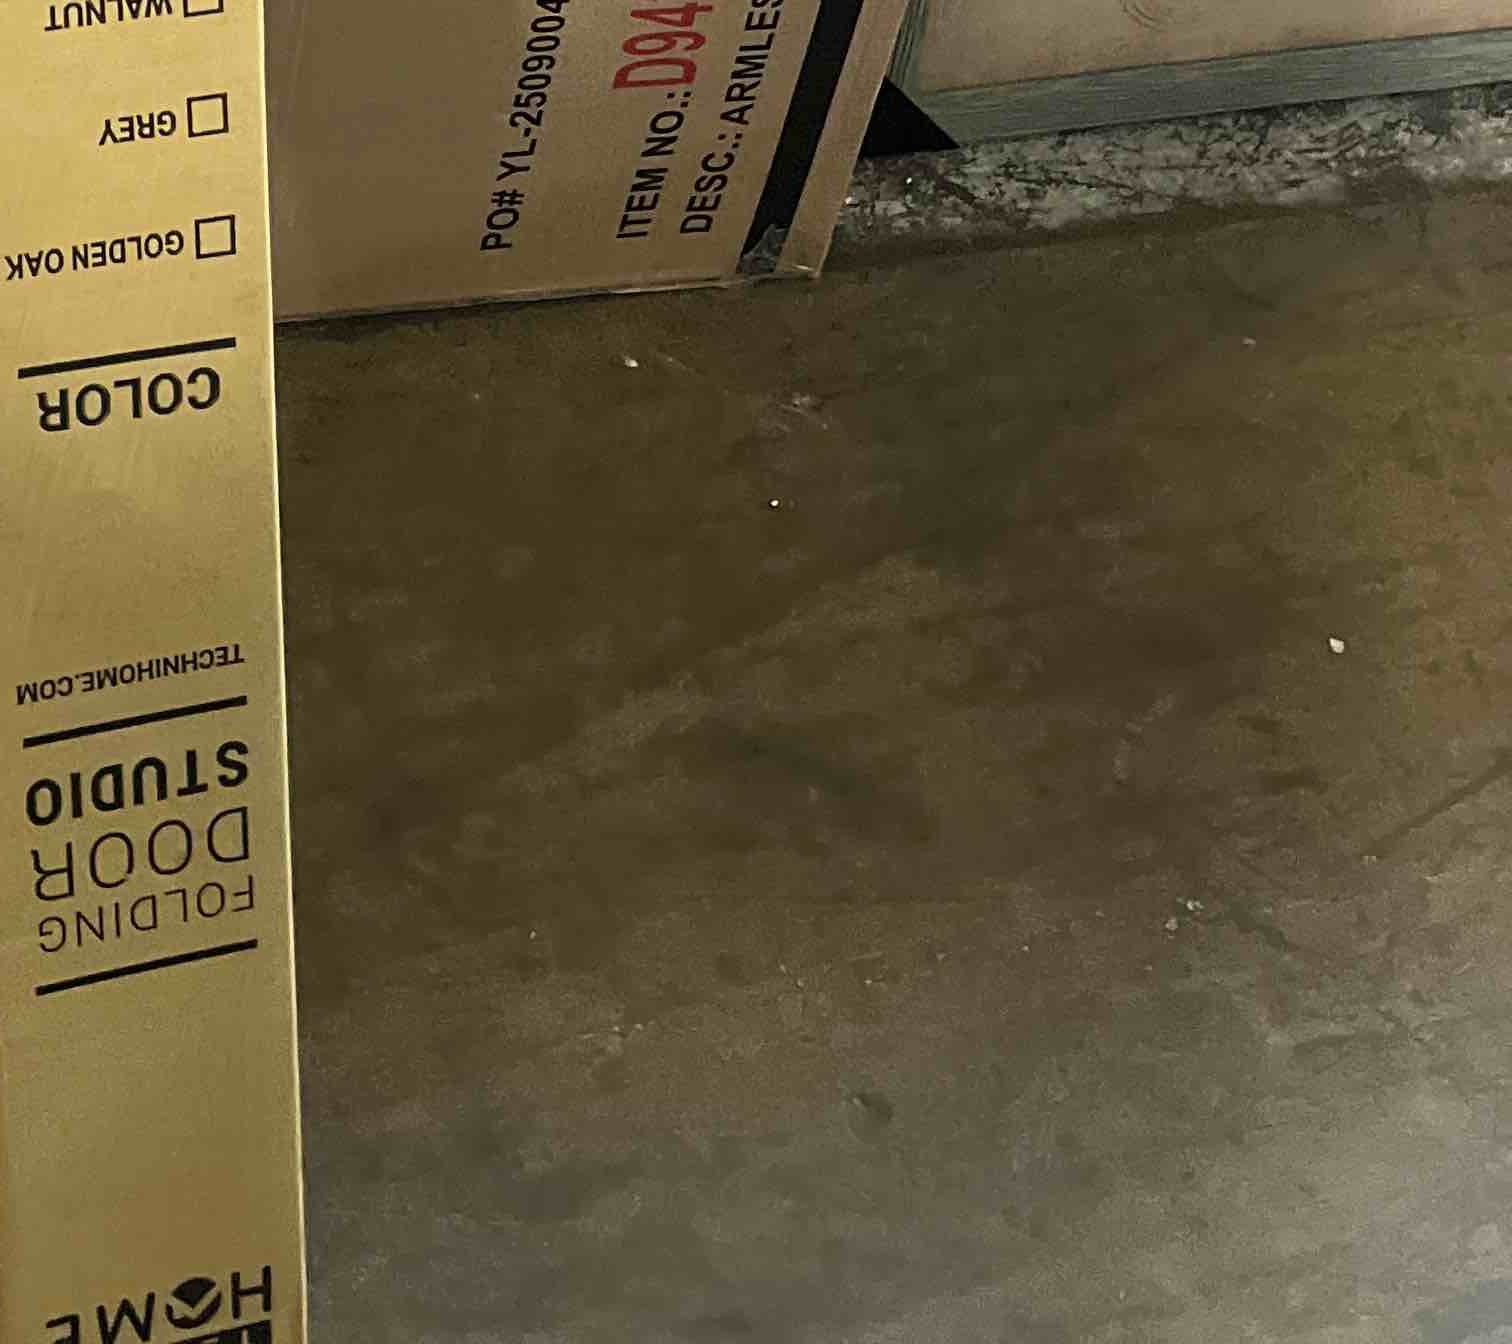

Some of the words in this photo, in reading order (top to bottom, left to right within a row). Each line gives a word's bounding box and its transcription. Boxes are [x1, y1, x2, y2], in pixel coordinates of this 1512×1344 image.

[98, 110, 177, 146] GREY
[480, 188, 526, 251] PO#
[615, 165, 669, 240] ITEM
[4, 247, 65, 281] OAK
[71, 229, 185, 271] GOLDEN
[36, 367, 222, 433] COLOR
[16, 643, 246, 705] TECHNIHOME.COM
[25, 740, 250, 827] STUDIO
[30, 806, 250, 902] DOOR
[38, 875, 256, 954] FOLDING
